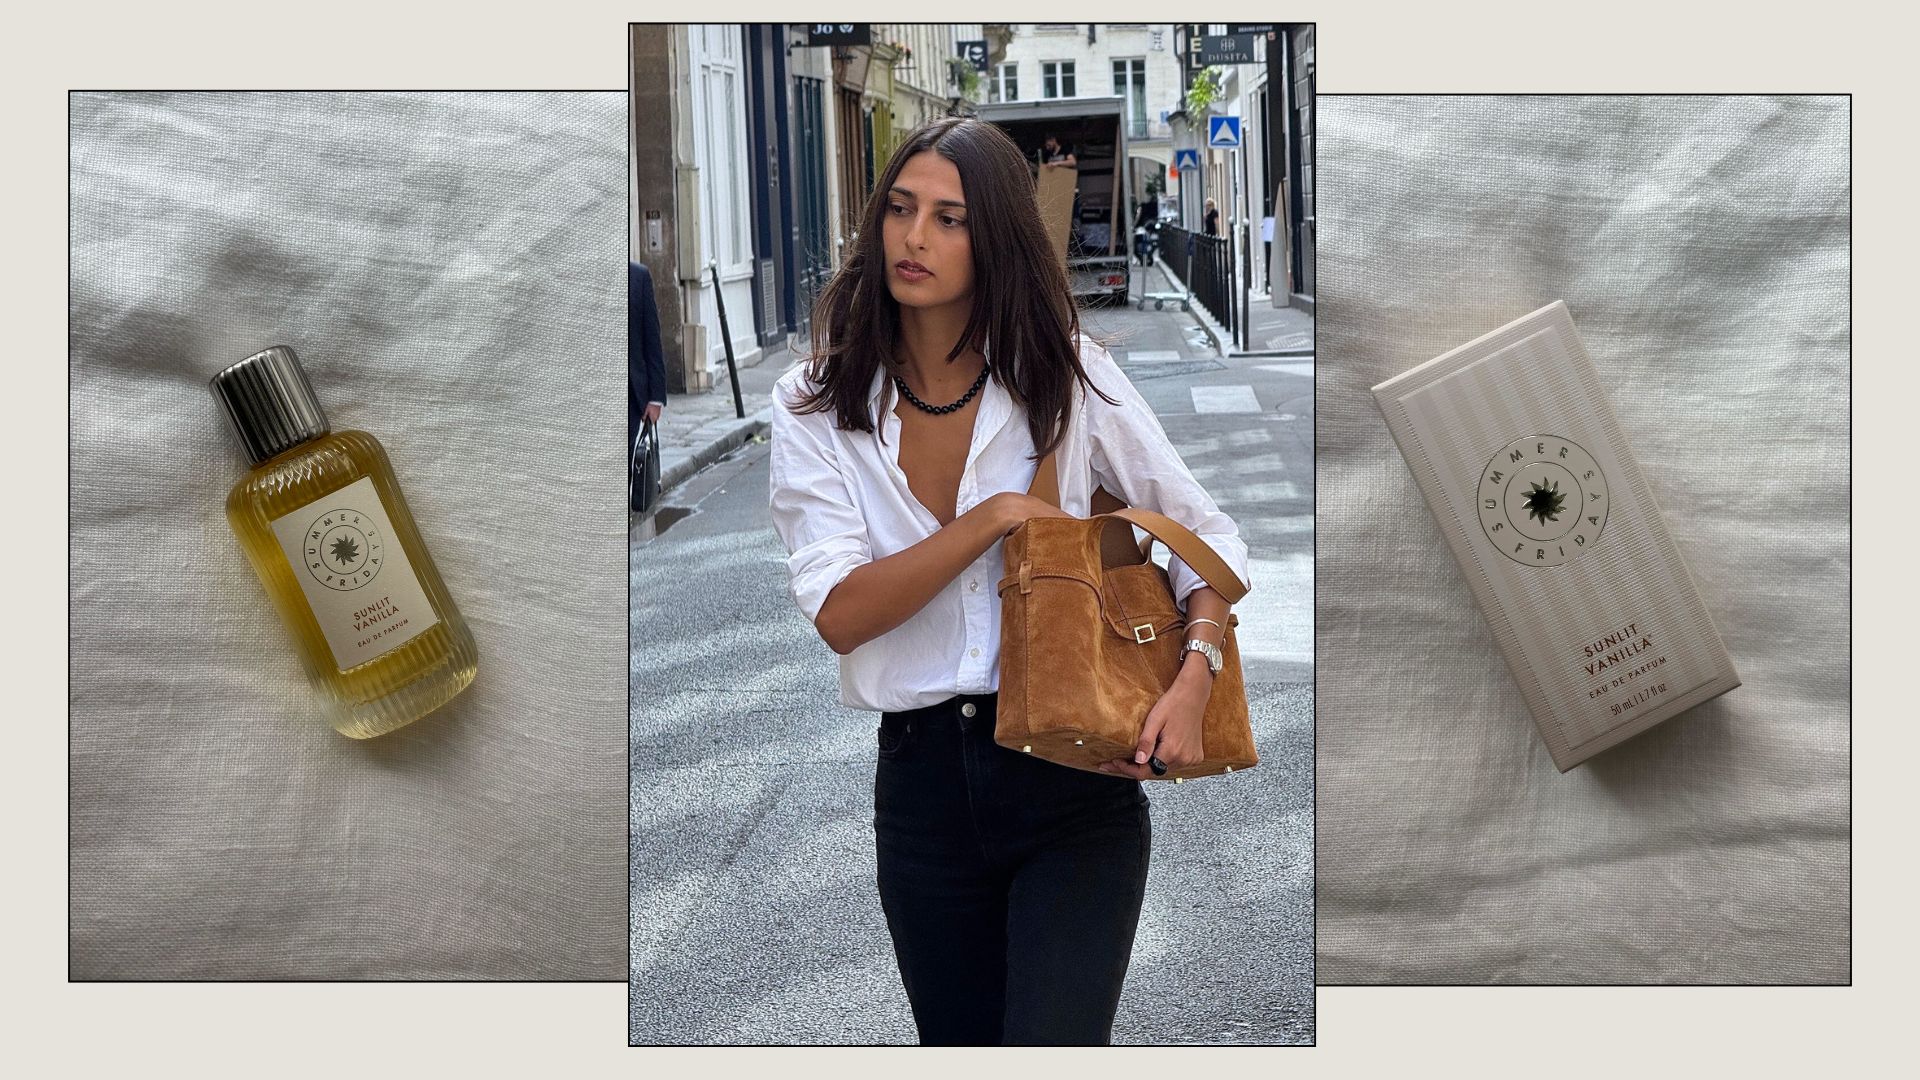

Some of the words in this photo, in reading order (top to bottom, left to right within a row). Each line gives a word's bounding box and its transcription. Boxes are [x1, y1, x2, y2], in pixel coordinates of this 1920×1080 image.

[1208, 53, 1248, 62] DUSITA
[1485, 442, 1569, 533] SUMMER
[1514, 470, 1602, 560] FRIDAYS
[308, 513, 360, 569] SUMMER
[326, 530, 380, 587] FRIDAYS
[353, 596, 390, 621] SUNLIT
[353, 605, 399, 632] VANILLA
[357, 638, 371, 648] EAU
[373, 632, 382, 641] DE
[384, 618, 409, 635] PARFUM
[1584, 623, 1637, 658] SUNLIT
[1589, 684, 1608, 699] EAU
[1612, 676, 1625, 688] DE
[1628, 656, 1667, 679] PARFUM
[1610, 703, 1622, 716] 50
[1638, 688, 1650, 703] 1.7
[1650, 685, 1658, 697] fl
[1657, 683, 1668, 694] oz
